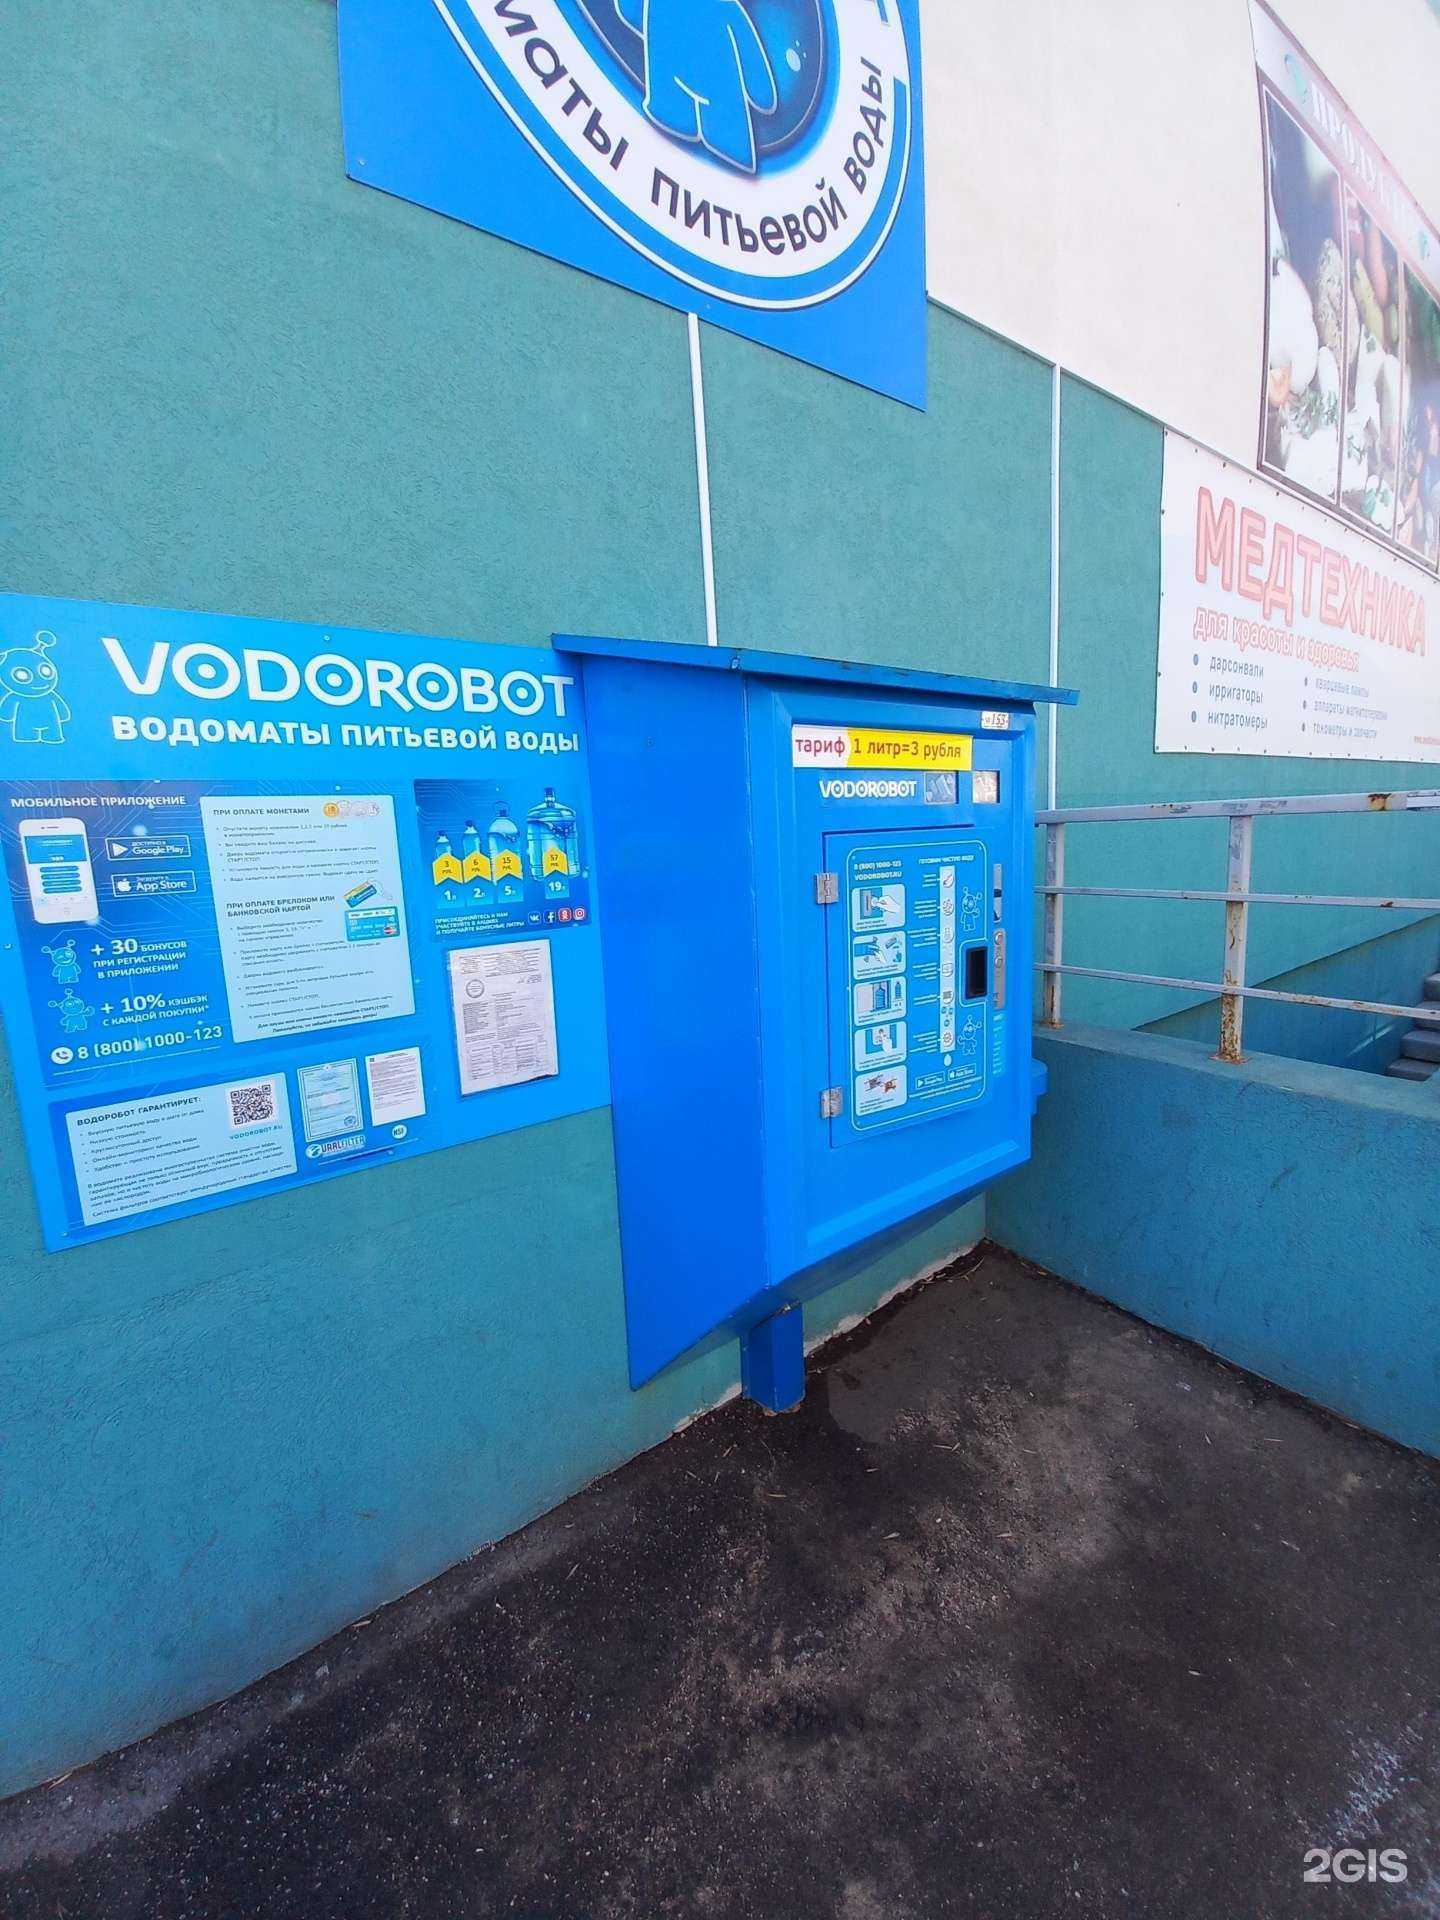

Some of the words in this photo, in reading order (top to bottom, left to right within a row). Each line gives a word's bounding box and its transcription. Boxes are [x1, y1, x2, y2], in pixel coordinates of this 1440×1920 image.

[649, 167, 848, 256] питьевой
[843, 56, 887, 195] воды
[1194, 486, 1426, 657] МЕДТЕХНИКА
[1193, 606, 1228, 641] для
[1232, 616, 1293, 656] красоты
[1308, 639, 1360, 673] здоровья
[1209, 654, 1264, 678] дарсонвали
[101, 637, 575, 718] VODOROBOT
[1208, 682, 1264, 704] ирригаторы
[1207, 710, 1268, 729] нитратомеры
[111, 715, 330, 747] ВОДОМАТЫ
[342, 722, 497, 750] ПИТЬЕВОЙ
[504, 730, 580, 755] ВОДЫ
[795, 737, 845, 757] тариф
[854, 738, 861, 753] 1
[867, 741, 919, 758] литр=3
[924, 743, 961, 760] рубля
[819, 780, 917, 798] VODOROBOT
[11, 797, 98, 808] МОБИЛЬНОЕ
[101, 796, 186, 807] ПРИЛОЖЕНИЕ
[233, 808, 264, 816] ОПЛАТЕ
[132, 845, 165, 857] Google
[166, 845, 184, 856] Play
[444, 860, 450, 868] 3
[473, 858, 479, 866] 6
[136, 881, 159, 893] App
[160, 879, 188, 890] Store
[226, 902, 243, 910] ПРИ
[245, 899, 276, 908] ОПЛАТЕ
[277, 896, 318, 906] БРЕЛОКОМ
[227, 905, 281, 917] БАНКОВСКОЙ
[282, 904, 311, 912] КАРТОЙ
[110, 939, 138, 954] 30
[140, 941, 187, 952] БОНУСОВ
[93, 960, 115, 969] ПРИ
[117, 952, 186, 966] РЕГИСТРАЦИИ
[107, 964, 179, 978] ПРИЛОЖЕНИИ
[120, 993, 166, 1013] 10%
[168, 995, 208, 1006] КЭШБЭК
[103, 1018, 110, 1026] С
[111, 1010, 157, 1026] КАЖДОЙ
[77, 1047, 89, 1059] 8
[144, 1026, 223, 1048] 1000-123
[77, 1110, 135, 1126] ВОДОРОБОТ
[138, 1097, 201, 1113] ГАРАНТИРУЕТ:
[230, 1125, 283, 1140] VODOROBOT.RU
